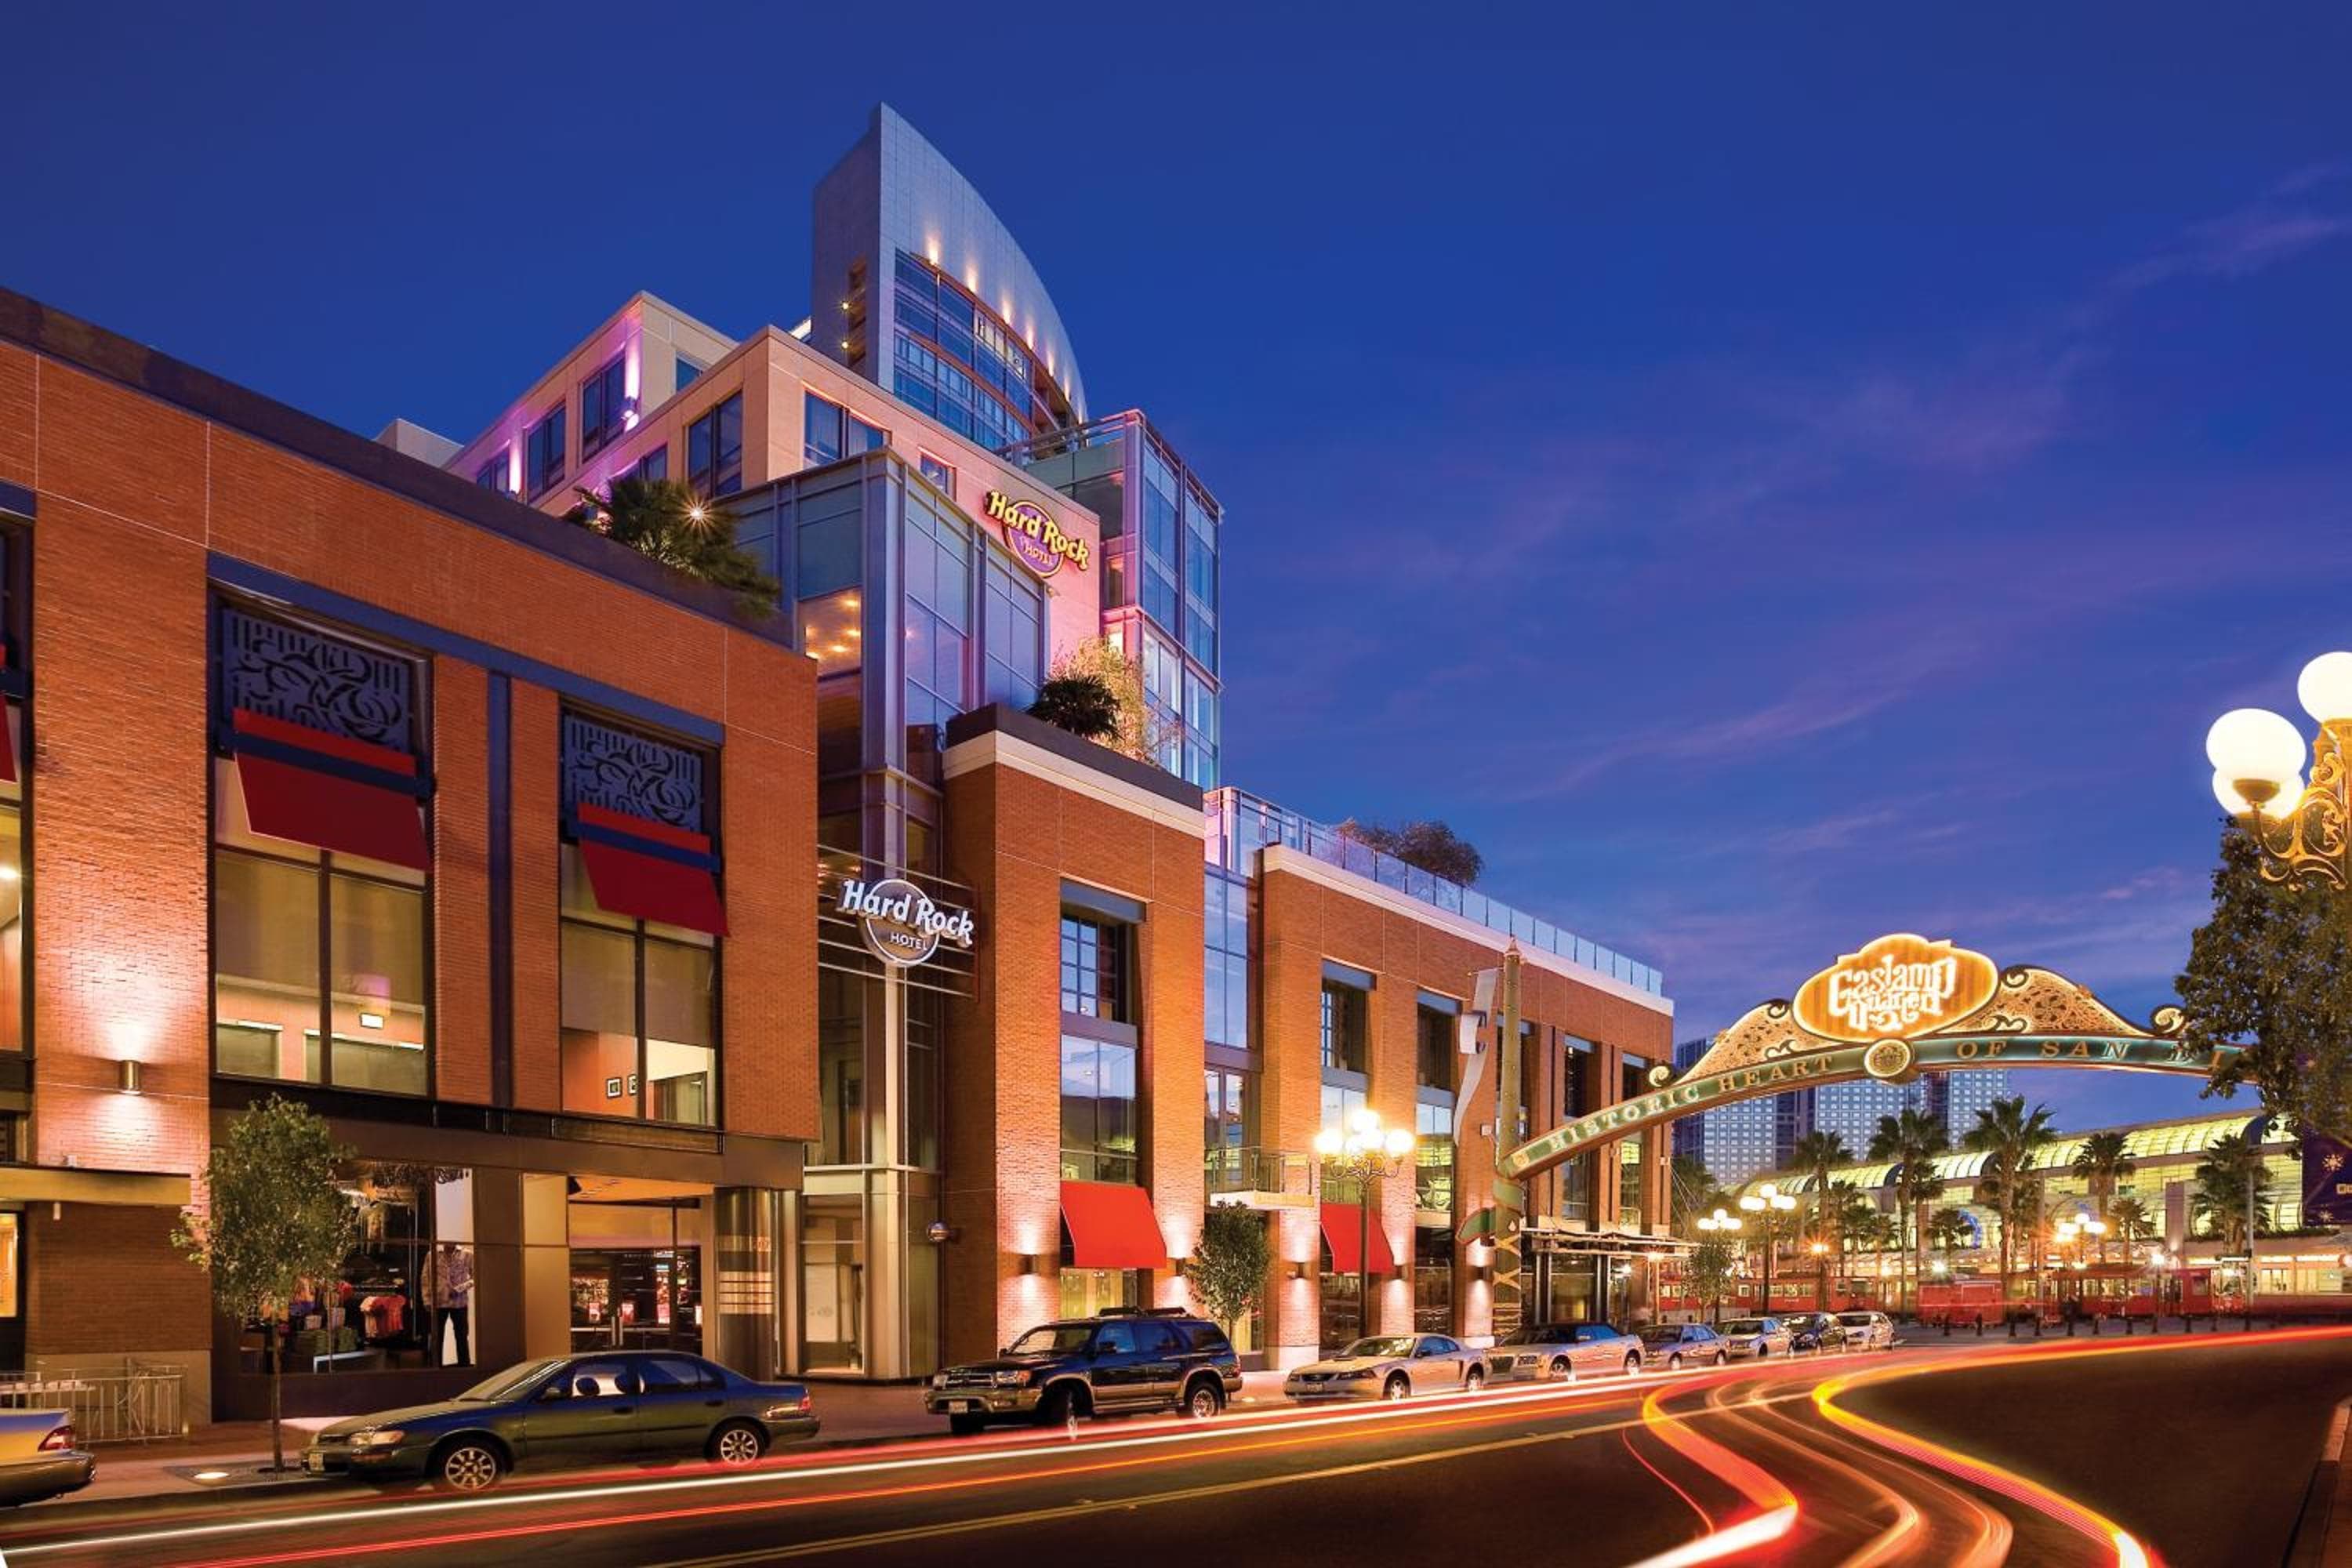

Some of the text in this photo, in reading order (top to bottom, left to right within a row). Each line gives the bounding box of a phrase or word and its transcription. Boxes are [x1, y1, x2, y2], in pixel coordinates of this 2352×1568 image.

[987, 490, 1090, 570] Hard Rock
[842, 878, 975, 946] Hard Rock
[890, 932, 928, 951] HOTEL
[1550, 1085, 1700, 1150] HISTORIC
[1717, 1055, 1833, 1092] HEART
[1956, 1040, 2008, 1059] OF
[2041, 1040, 2132, 1059] SAN
